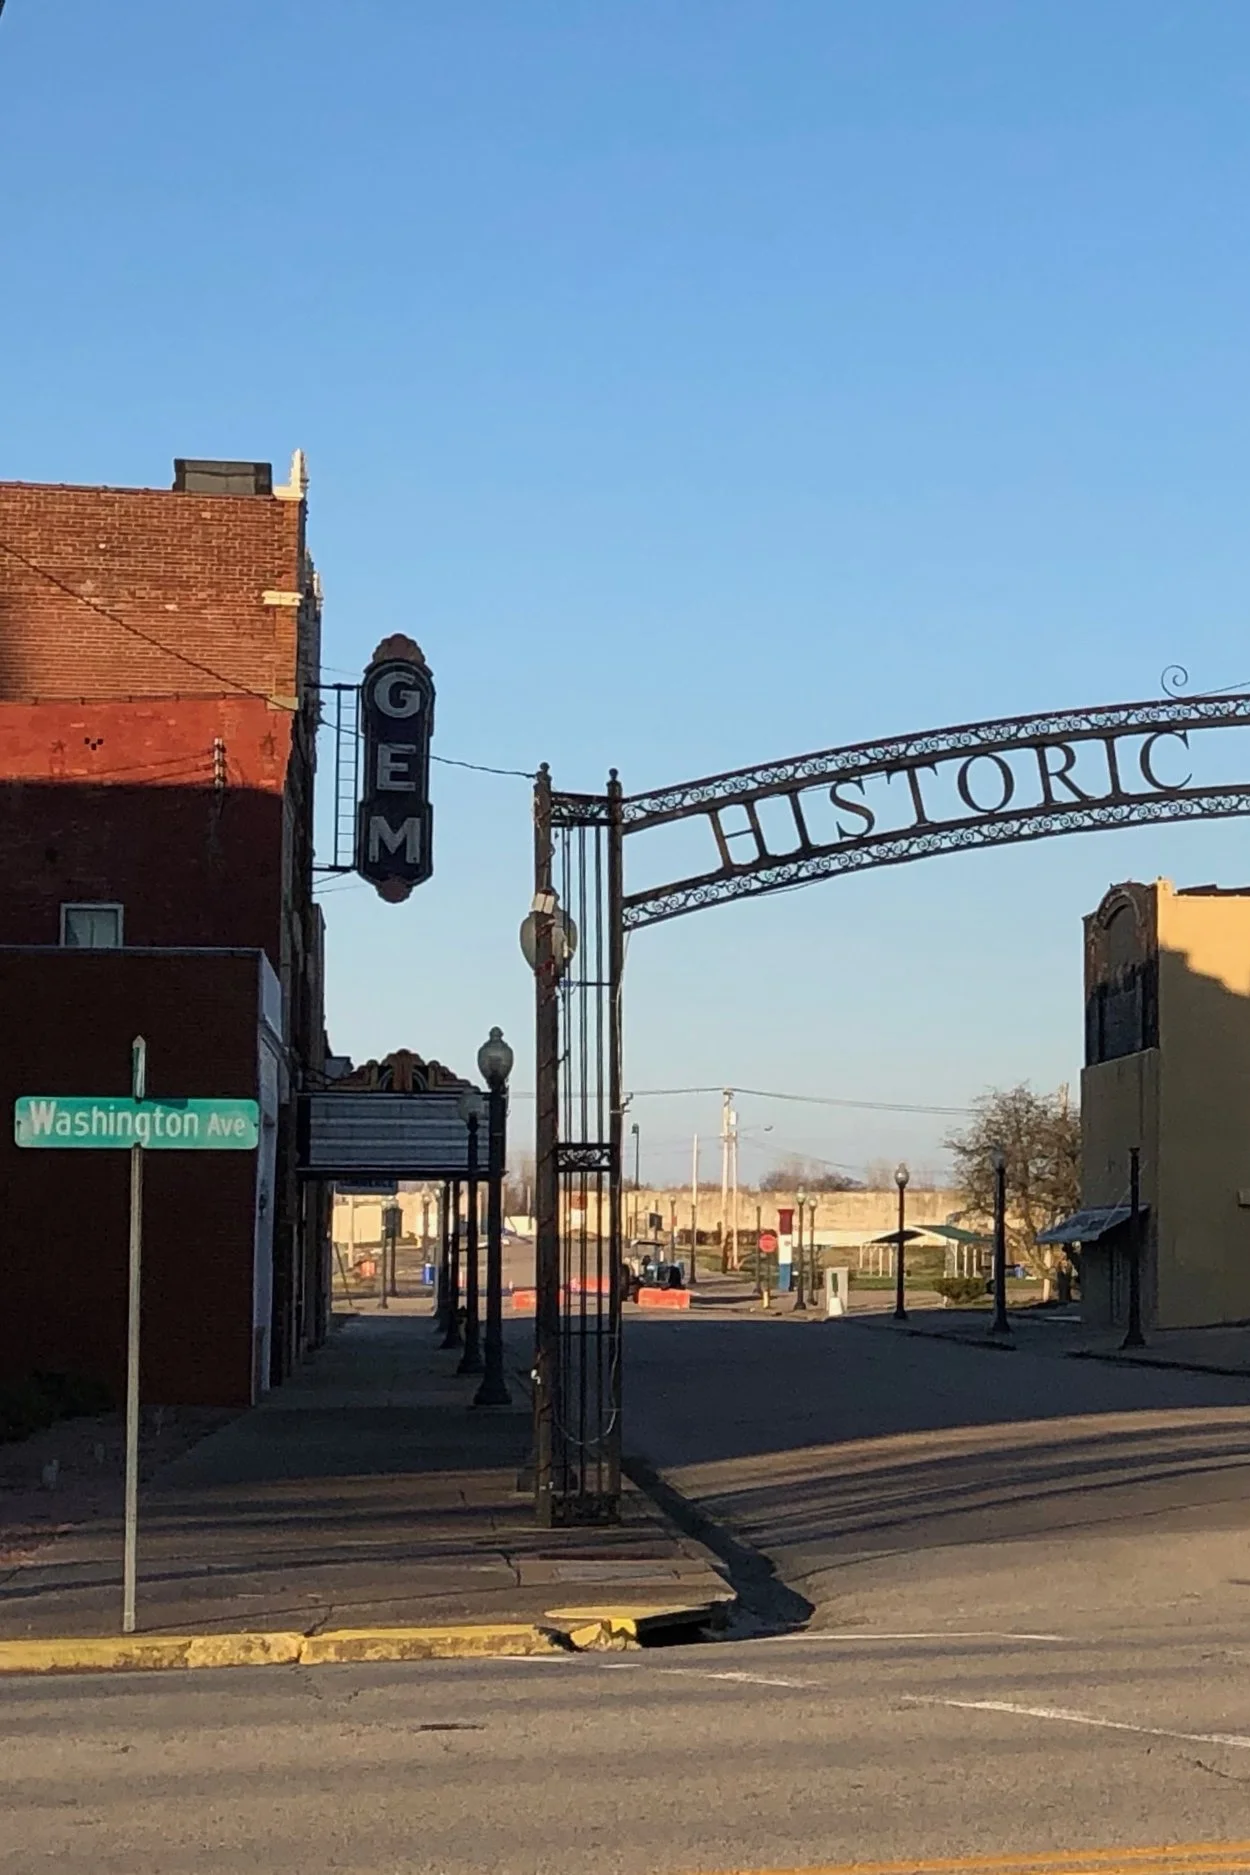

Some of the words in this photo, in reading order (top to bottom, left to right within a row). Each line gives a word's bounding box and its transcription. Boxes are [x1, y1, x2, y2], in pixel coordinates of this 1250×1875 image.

[368, 671, 421, 865] GEM
[708, 731, 1194, 872] HISTORIC
[29, 1100, 199, 1144] Washington
[207, 1113, 246, 1137] Ave
